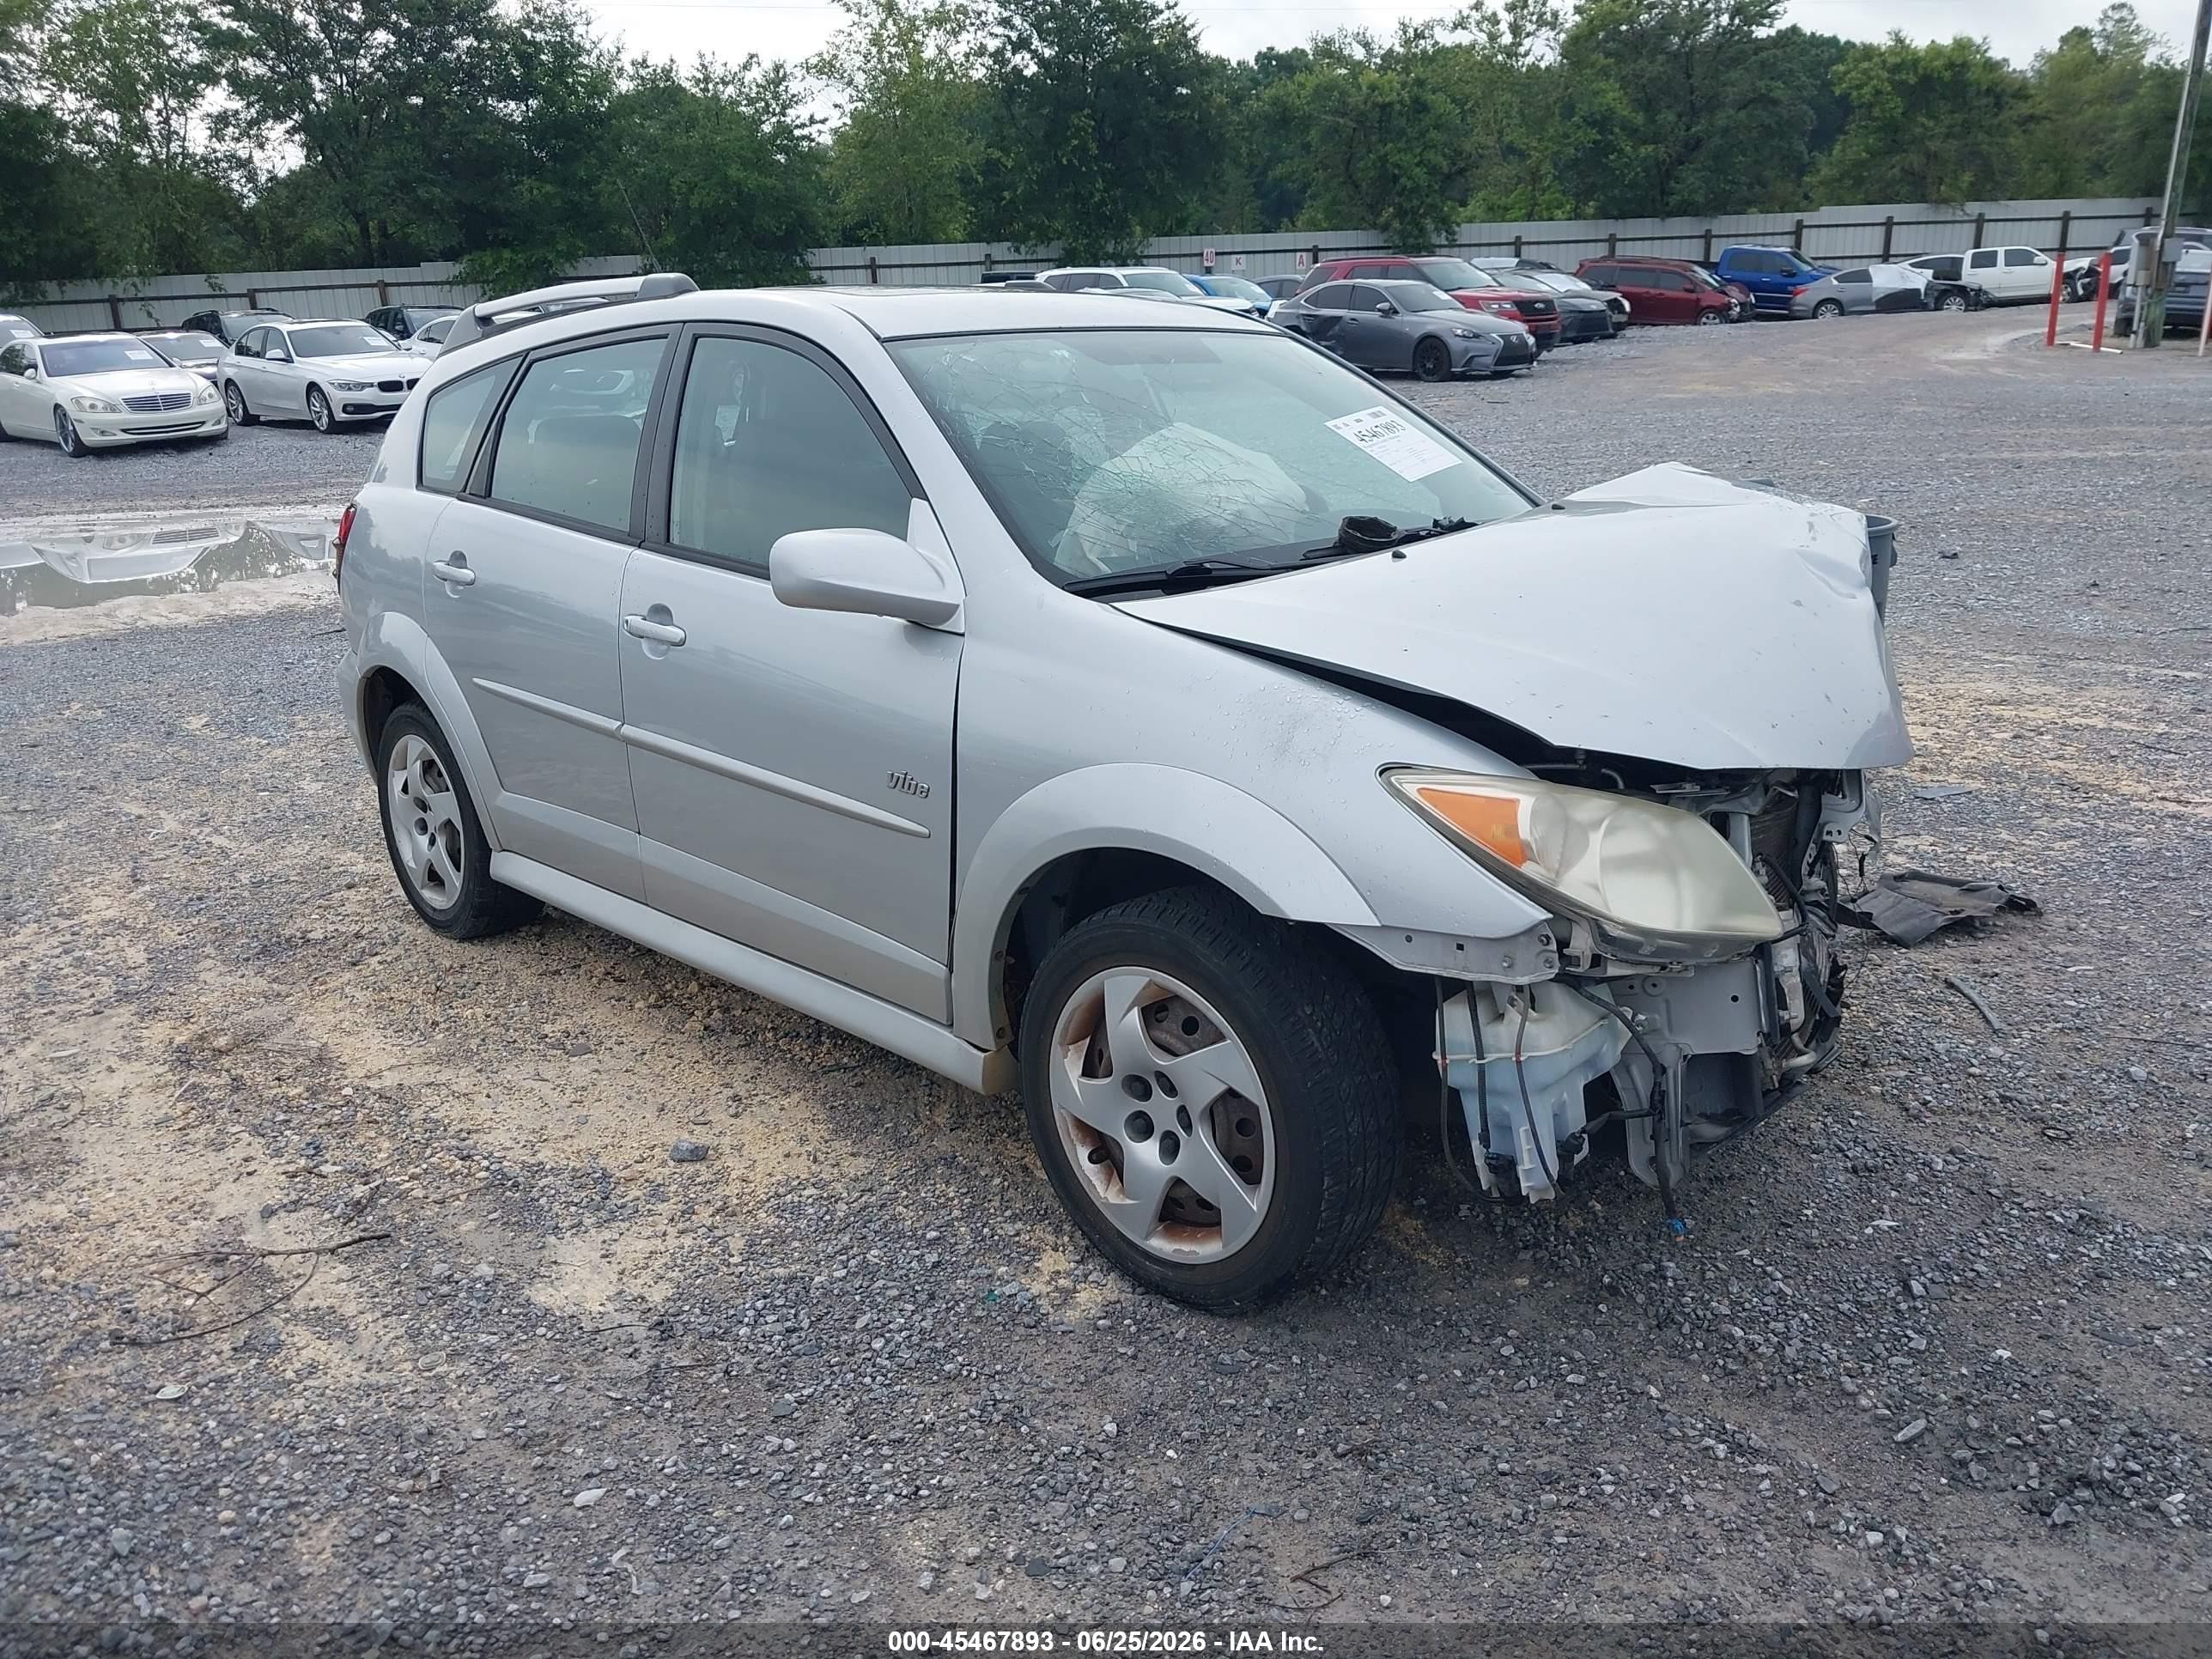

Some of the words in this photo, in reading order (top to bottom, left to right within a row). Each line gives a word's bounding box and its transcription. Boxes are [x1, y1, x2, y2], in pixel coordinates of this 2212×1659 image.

[1205, 250, 1214, 264] 40
[1236, 257, 1242, 266] K
[1297, 254, 1305, 268] A
[1352, 419, 1406, 443] 45467893
